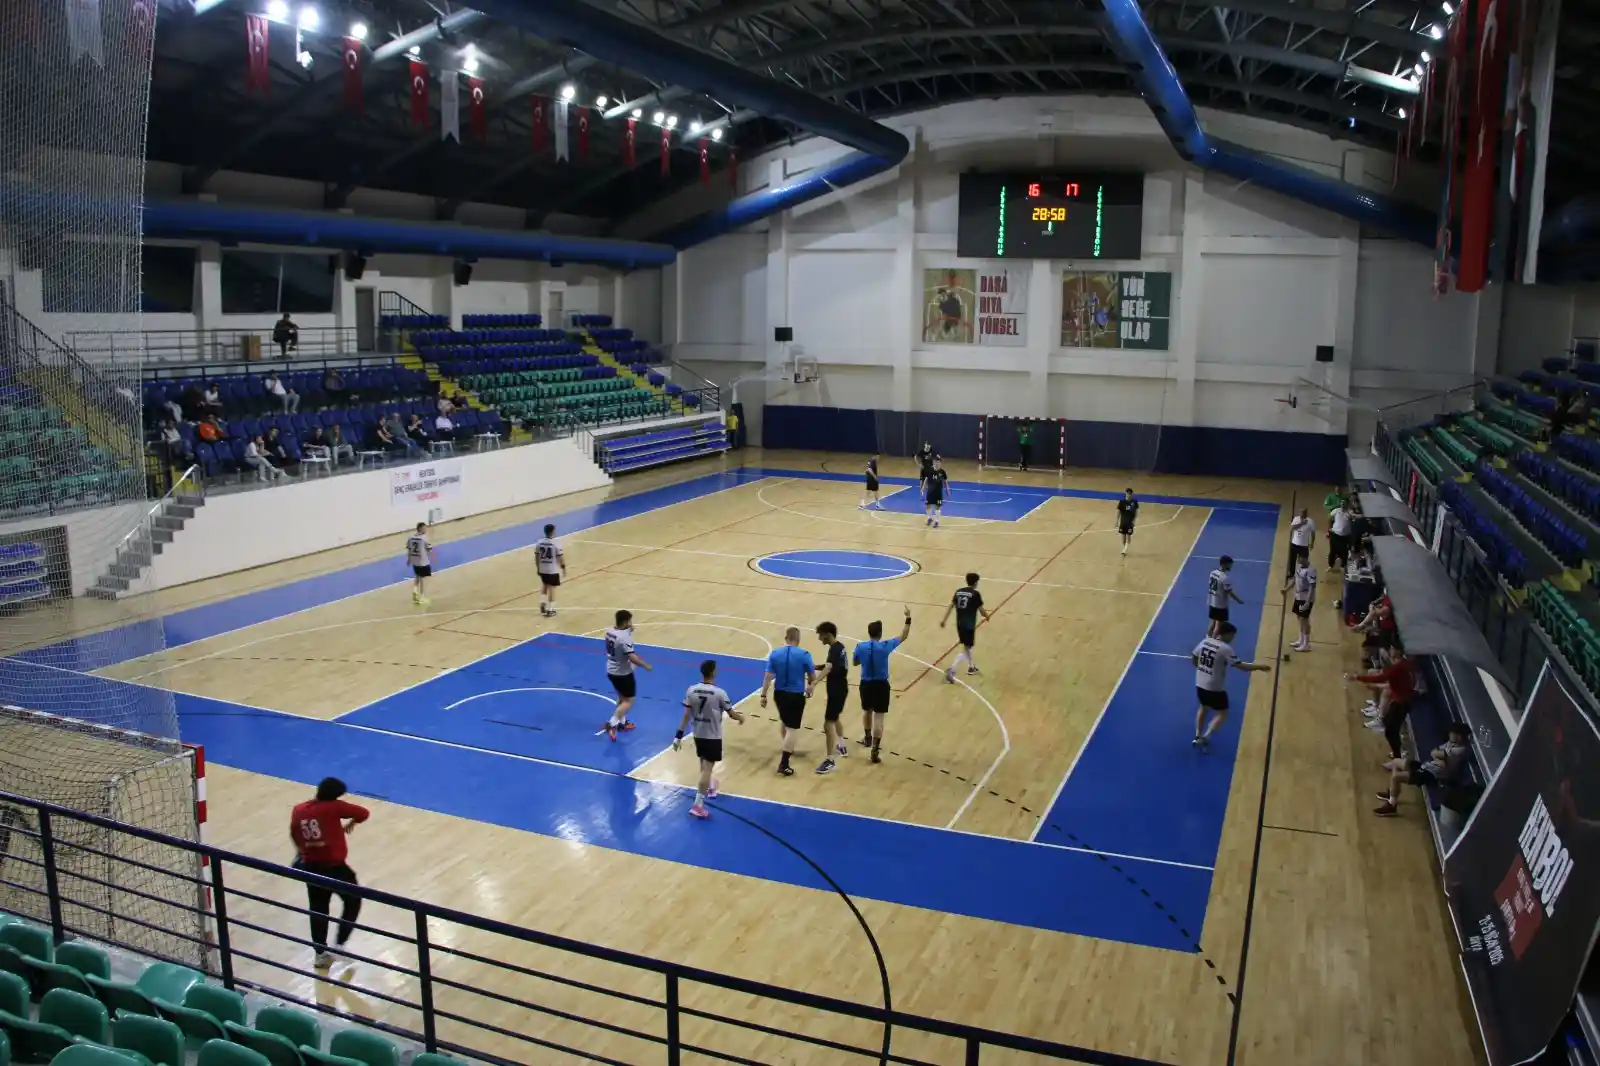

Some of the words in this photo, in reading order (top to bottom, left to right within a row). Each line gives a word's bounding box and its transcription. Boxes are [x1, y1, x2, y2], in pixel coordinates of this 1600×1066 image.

[1029, 184, 1040, 197] 16
[1066, 184, 1079, 197] 17
[1032, 207, 1066, 221] 28:58
[540, 547, 553, 559] 24
[957, 595, 969, 609] 13
[1199, 647, 1217, 668] 55
[698, 695, 708, 714] 7
